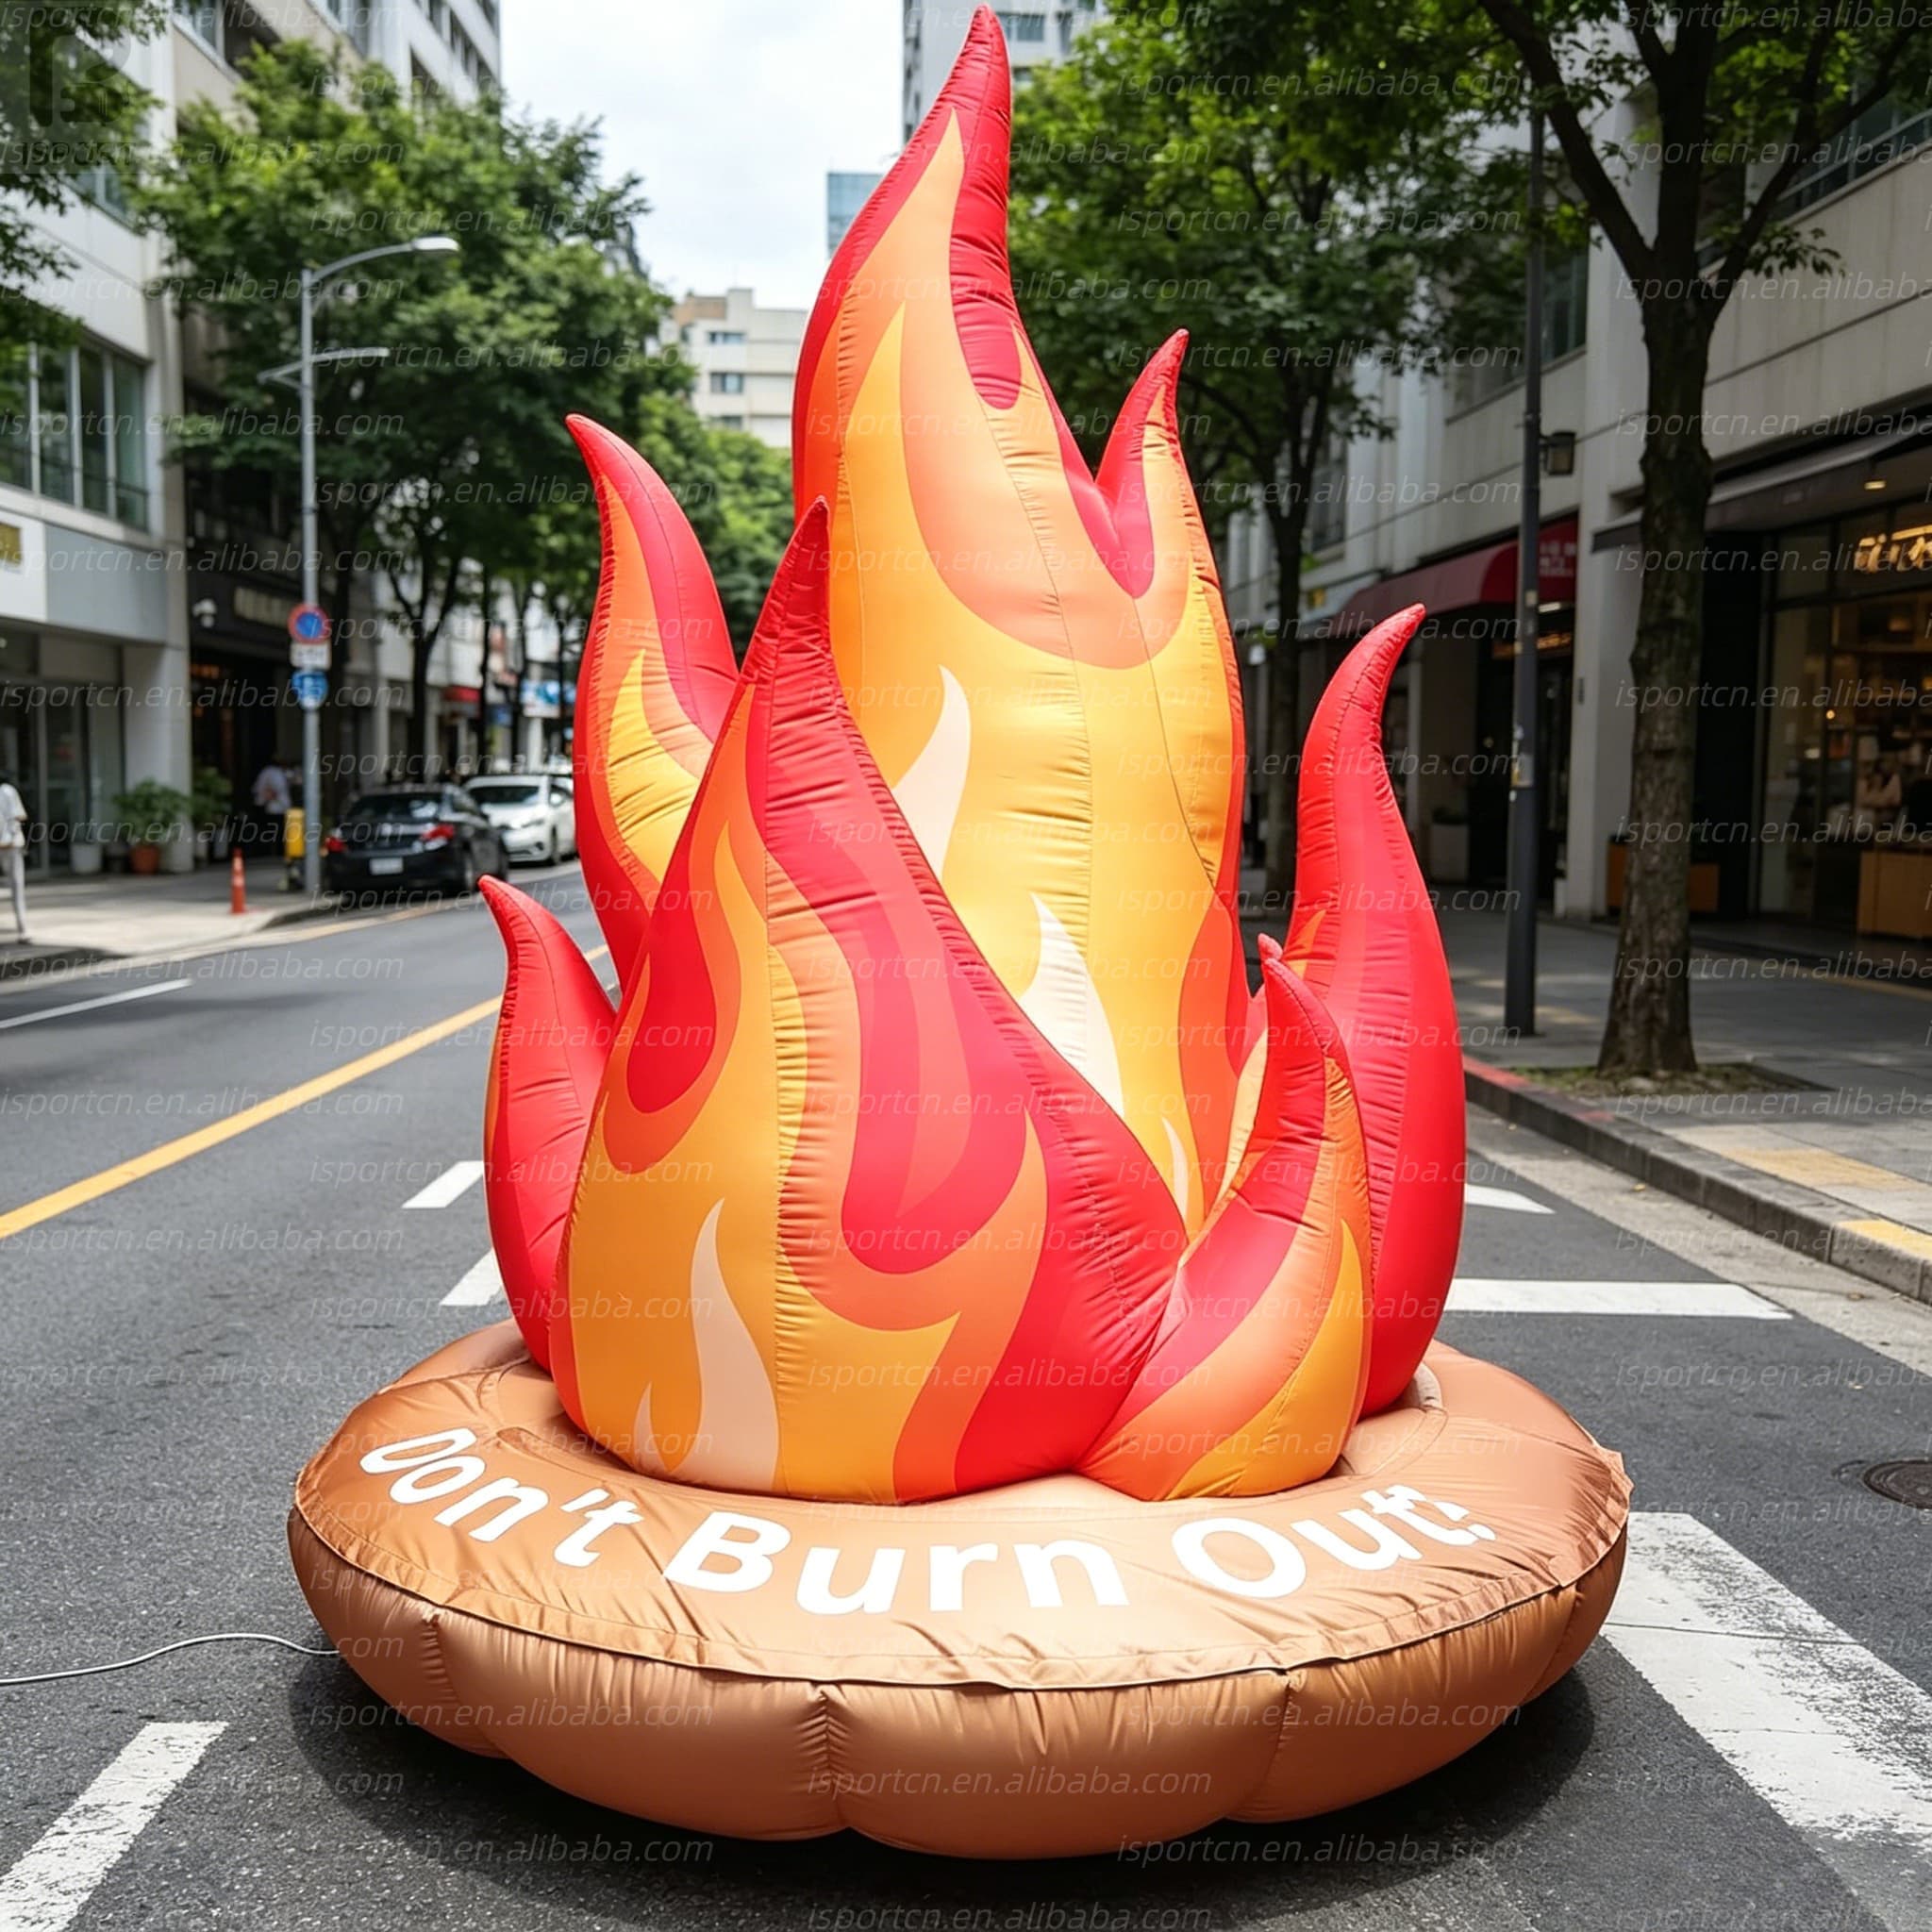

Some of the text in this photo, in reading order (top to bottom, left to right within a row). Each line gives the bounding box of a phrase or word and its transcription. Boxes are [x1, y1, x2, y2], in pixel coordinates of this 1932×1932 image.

[359, 1427, 1496, 1614] Don't Burn Out!
